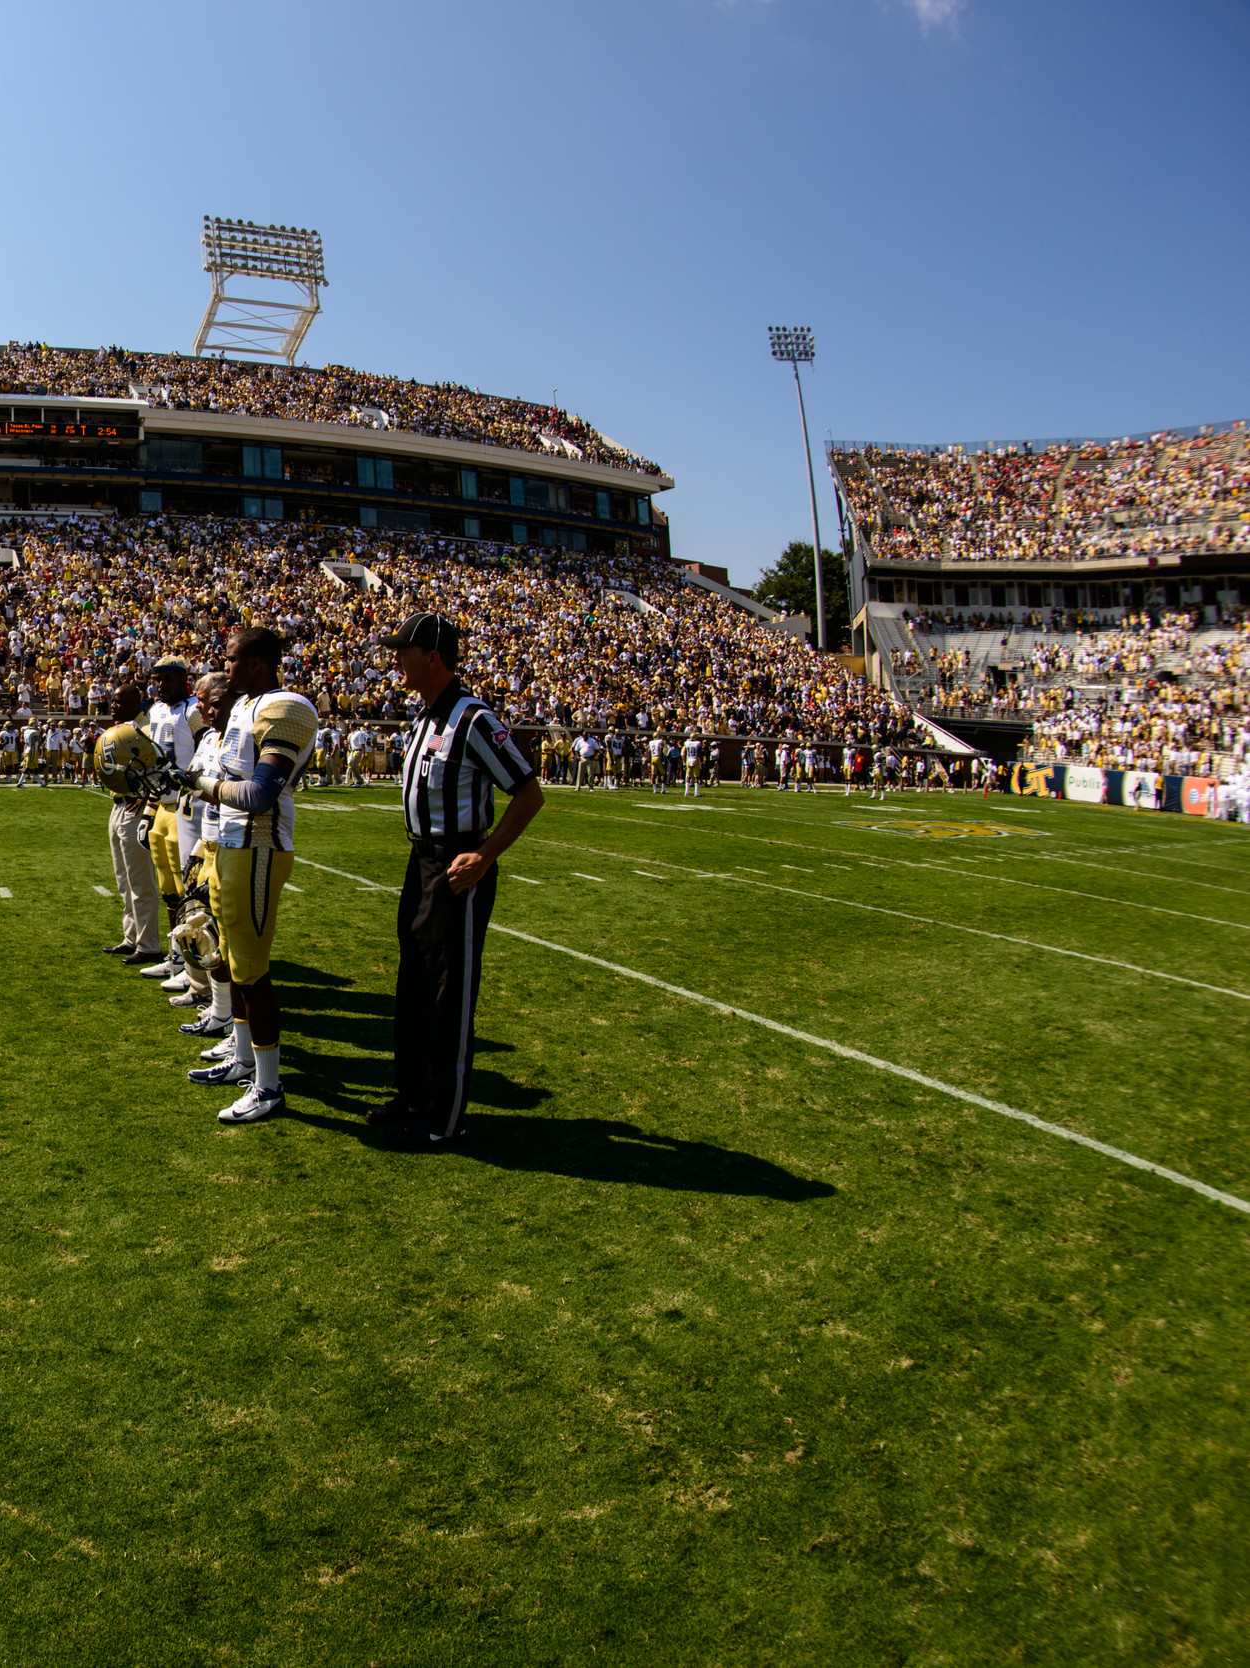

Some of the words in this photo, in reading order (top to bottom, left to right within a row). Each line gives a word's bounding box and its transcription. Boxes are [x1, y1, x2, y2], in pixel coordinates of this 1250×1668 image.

[97, 427, 117, 436] 2:54
[421, 760, 430, 777] U
[1011, 761, 1054, 798] GT
[1068, 775, 1101, 790] Publix
